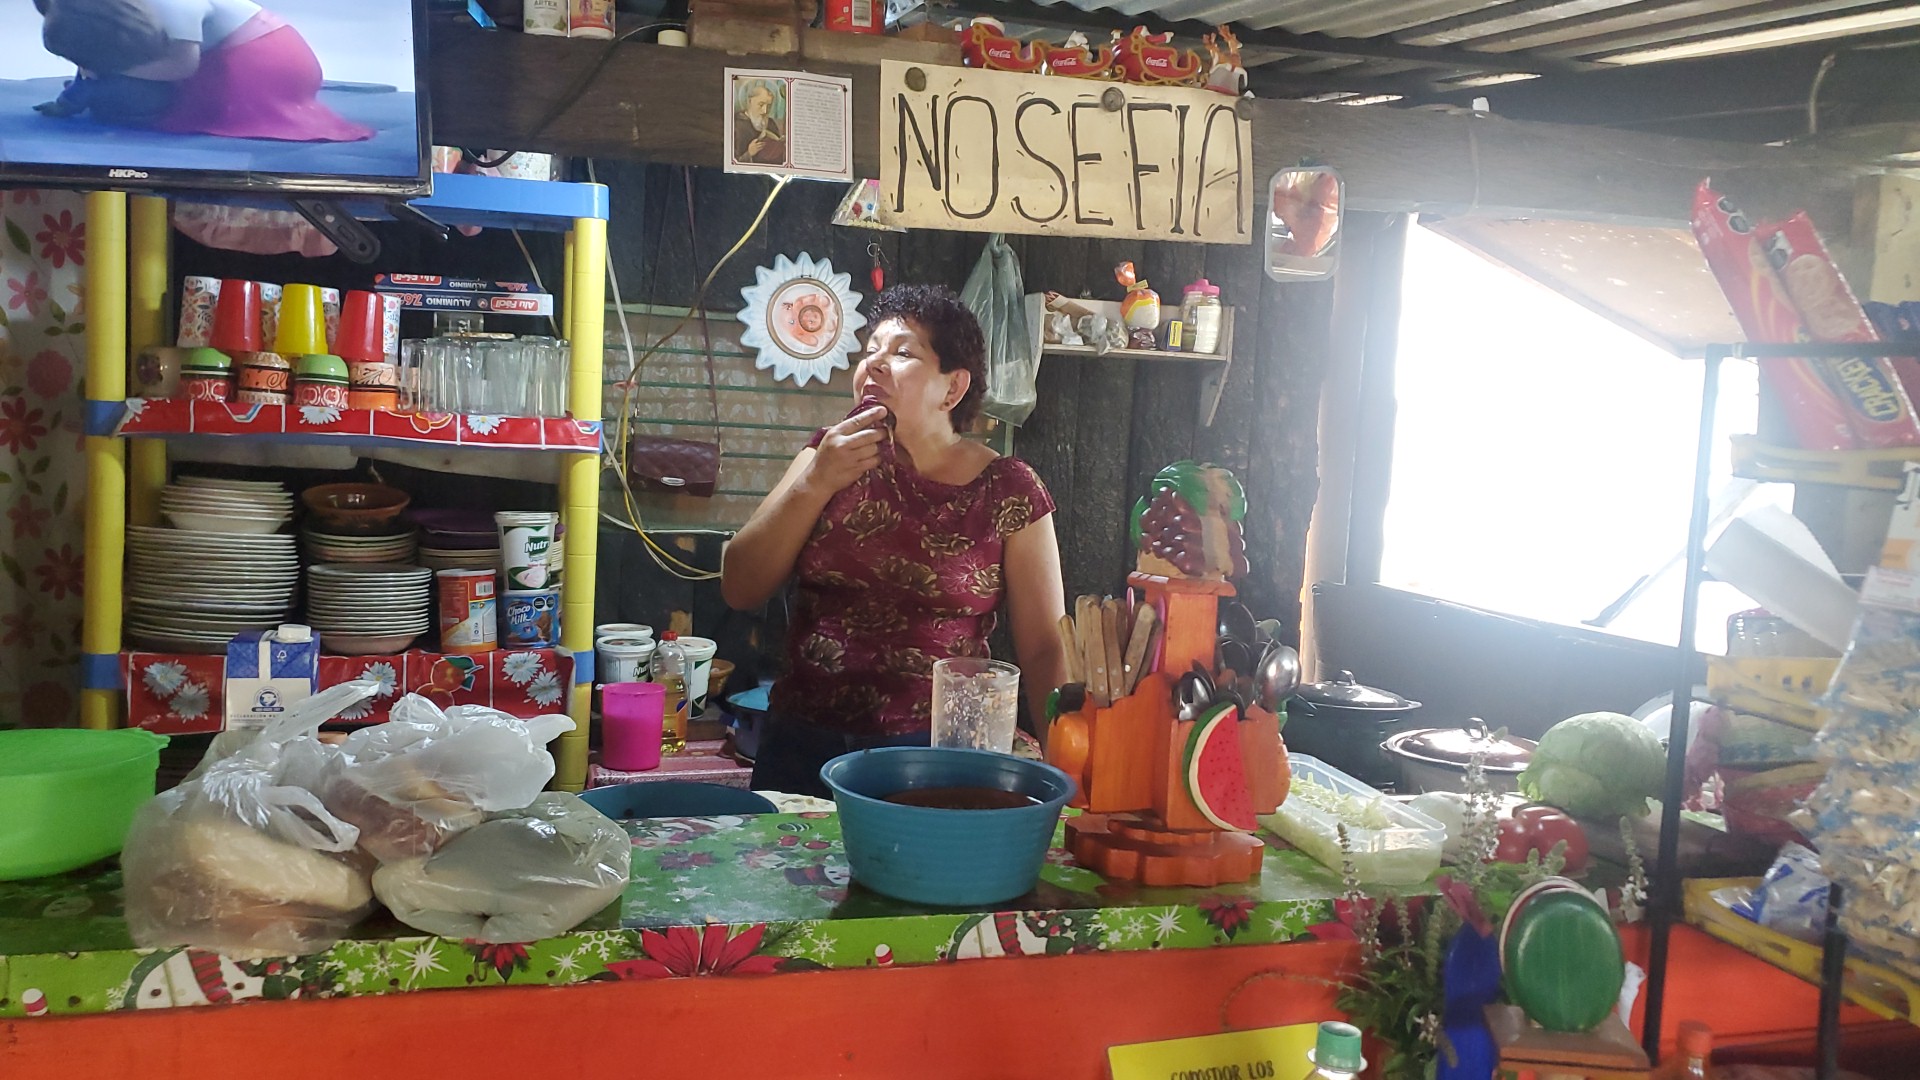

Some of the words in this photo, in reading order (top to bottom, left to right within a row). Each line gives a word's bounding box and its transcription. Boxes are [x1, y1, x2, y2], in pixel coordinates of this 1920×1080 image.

[894, 93, 999, 219] NO
[1011, 98, 1113, 225] SE
[1127, 102, 1245, 236] FIA
[449, 281, 487, 289] ALUMINIO
[426, 297, 471, 307] ALUMINIO
[519, 300, 535, 309] Alu
[507, 605, 531, 616] Choco
[511, 612, 529, 625] Milk
